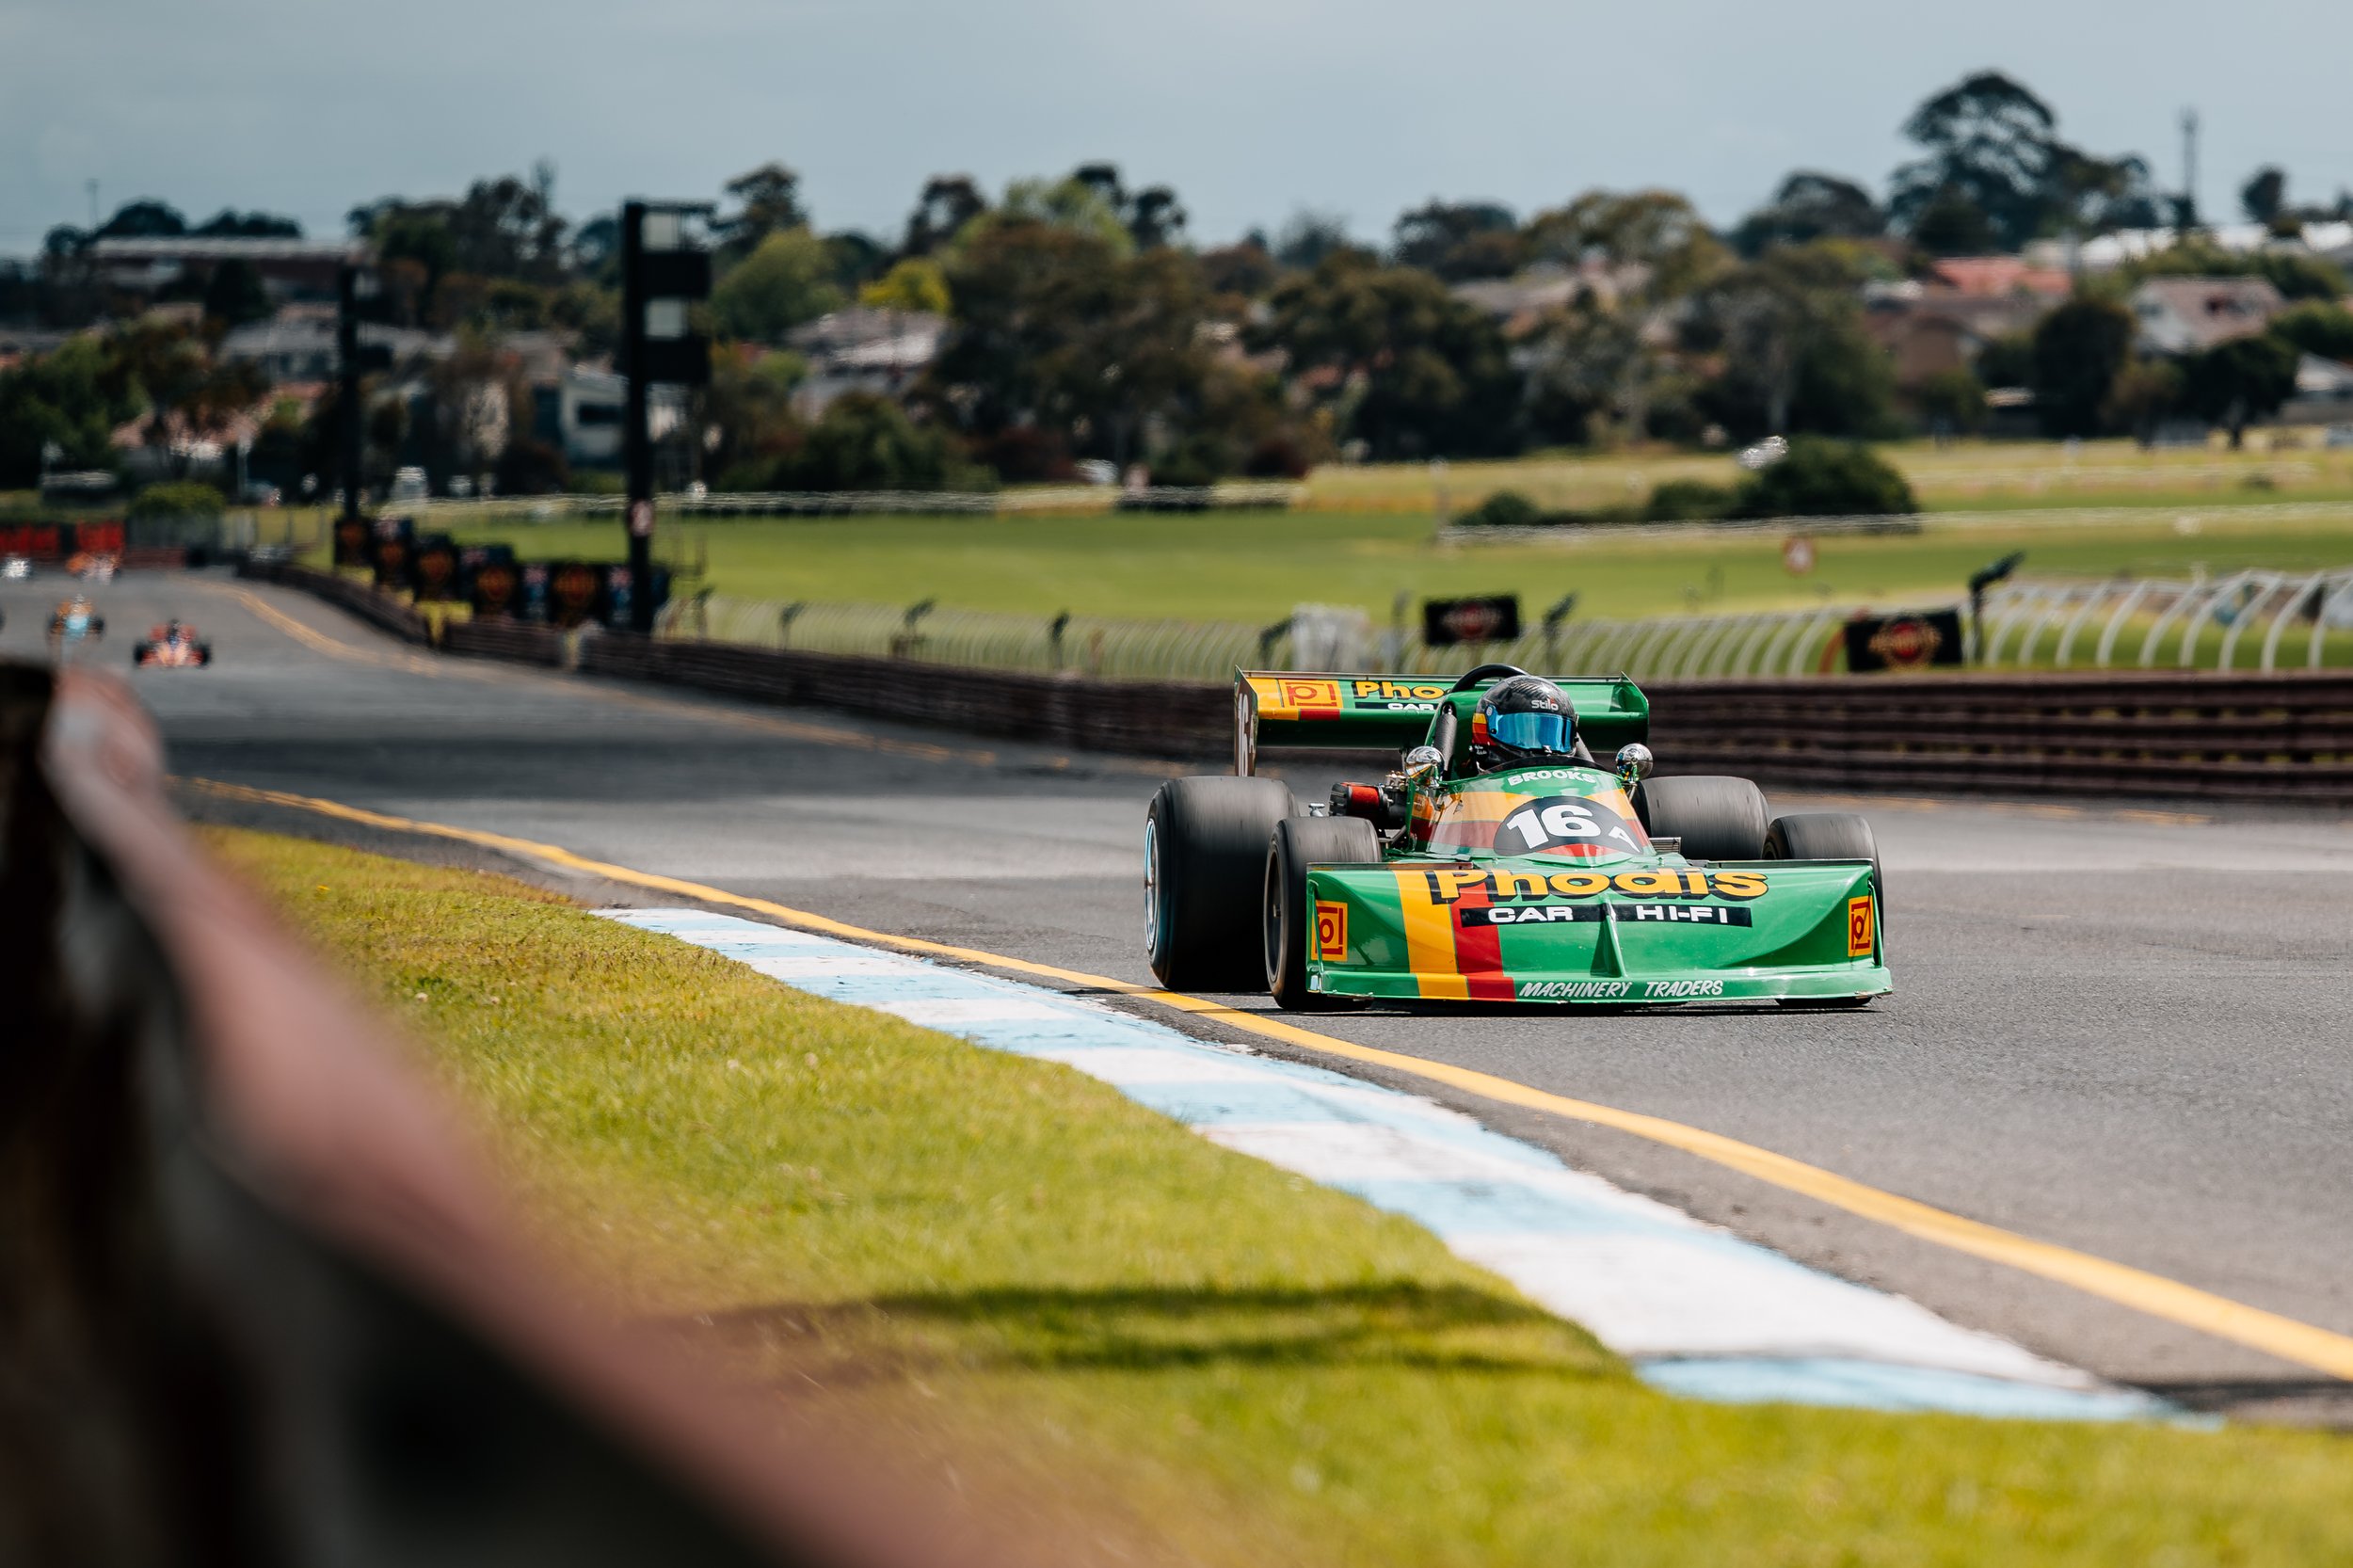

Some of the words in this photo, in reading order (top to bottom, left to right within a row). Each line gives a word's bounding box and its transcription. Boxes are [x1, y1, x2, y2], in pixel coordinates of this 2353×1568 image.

[1352, 680, 1453, 700] Pho
[1530, 695, 1560, 712] Stilo
[1508, 770, 1597, 787] BROOKS
[1506, 804, 1602, 850] 16
[1609, 825, 1641, 854] A
[1425, 868, 1769, 904] Phodis
[1487, 905, 1575, 923] CAR
[1636, 904, 1729, 924] HI-FI
[1518, 981, 1634, 998] MACHINERY
[1643, 979, 1724, 997] TRADERS
